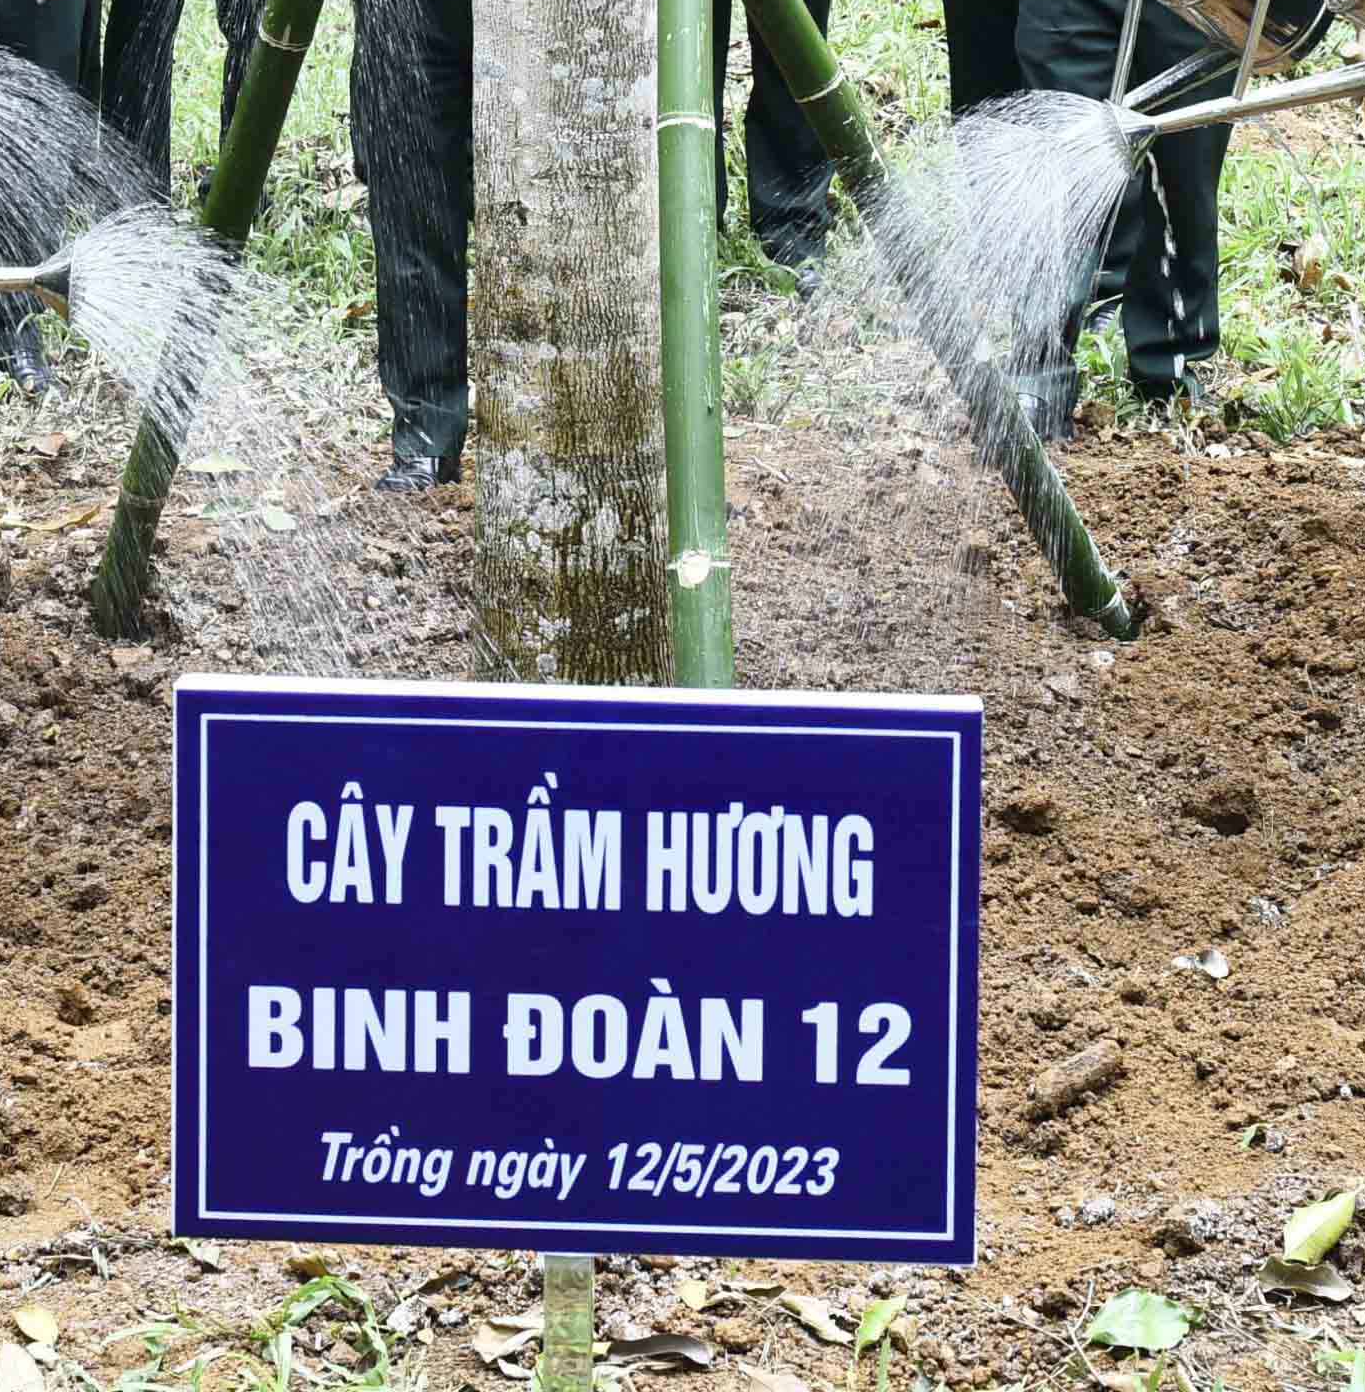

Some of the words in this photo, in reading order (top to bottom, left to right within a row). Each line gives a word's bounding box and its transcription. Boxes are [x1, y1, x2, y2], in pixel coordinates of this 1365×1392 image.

[286, 781, 415, 906] CÂY
[435, 771, 622, 912] TRẦM
[646, 801, 875, 918] HƯƠNG
[248, 985, 471, 1075] BINH
[502, 977, 765, 1083] ĐOÀN
[801, 1001, 913, 1087] 12
[320, 1125, 454, 1198] Trồng
[466, 1137, 588, 1202] ngày
[607, 1141, 841, 1199] 12/5/2023
